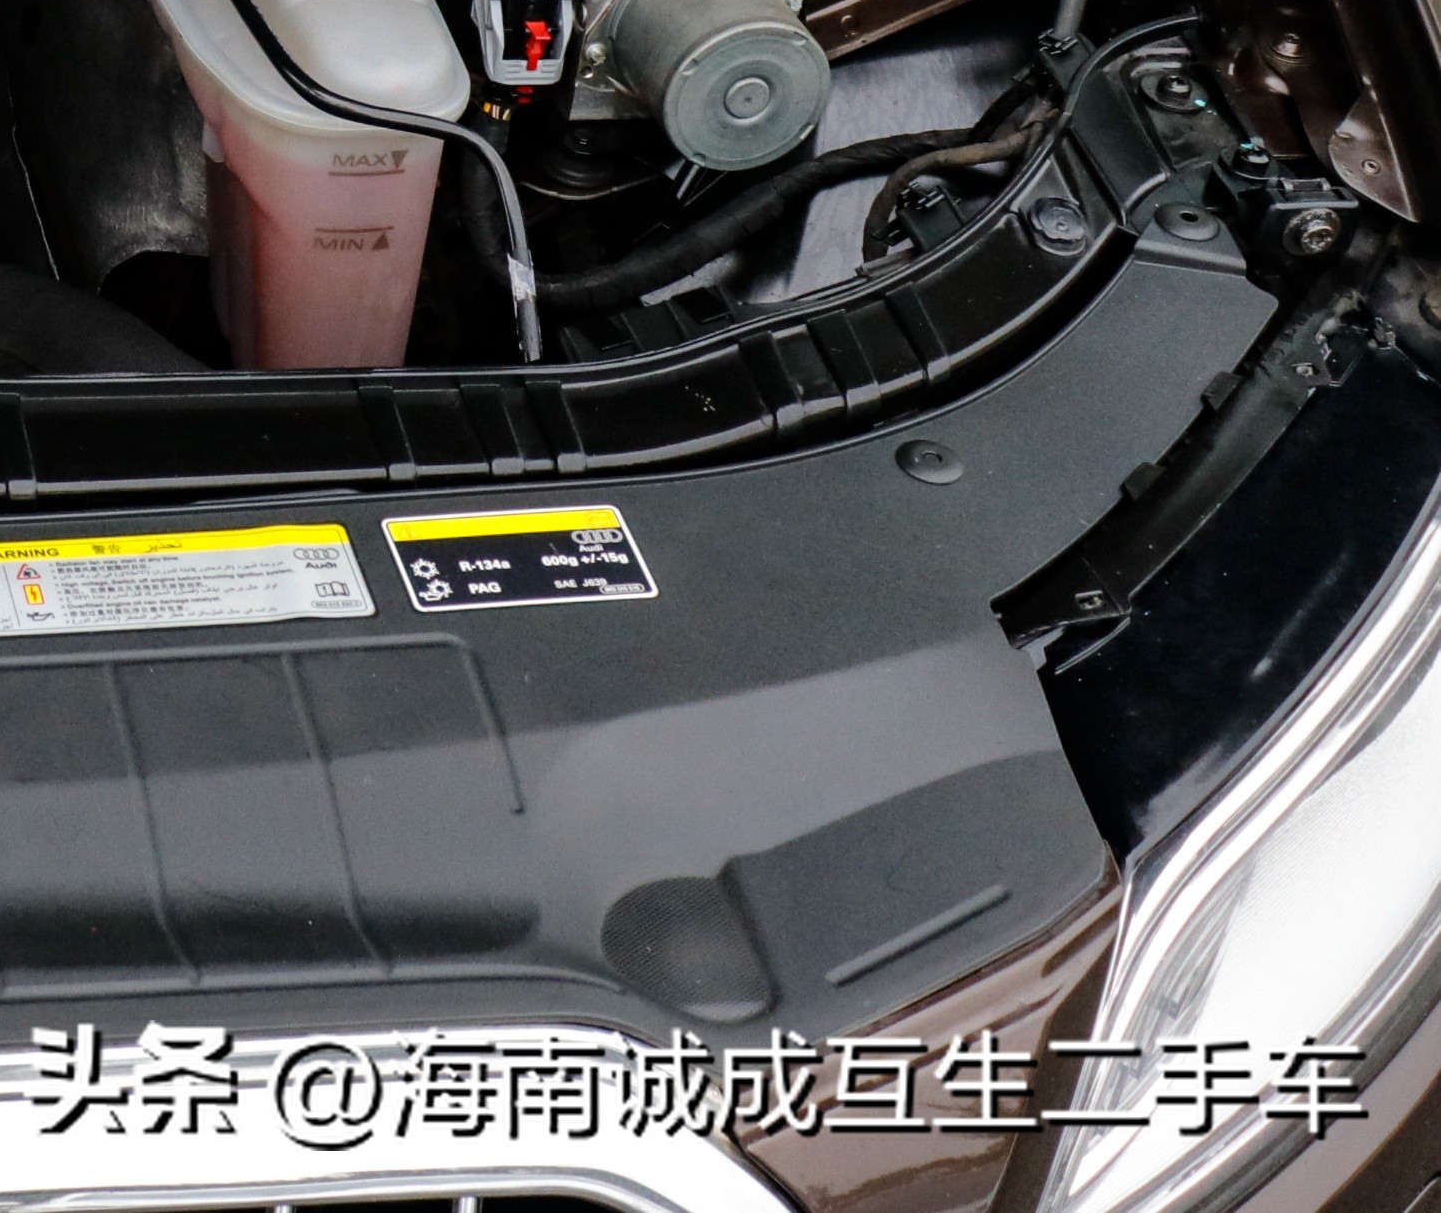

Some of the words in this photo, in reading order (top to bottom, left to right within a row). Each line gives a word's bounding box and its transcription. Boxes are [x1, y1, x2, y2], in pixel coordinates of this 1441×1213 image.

[332, 153, 388, 167] MAX
[313, 238, 364, 250] MIN
[579, 544, 604, 552] Audi
[305, 561, 337, 569] Audi
[459, 559, 512, 572] R-134a
[541, 555, 579, 567] 600g
[581, 552, 629, 564] +/-15g
[468, 581, 502, 594] PAG
[554, 579, 578, 589] SAE
[582, 578, 608, 587] J639
